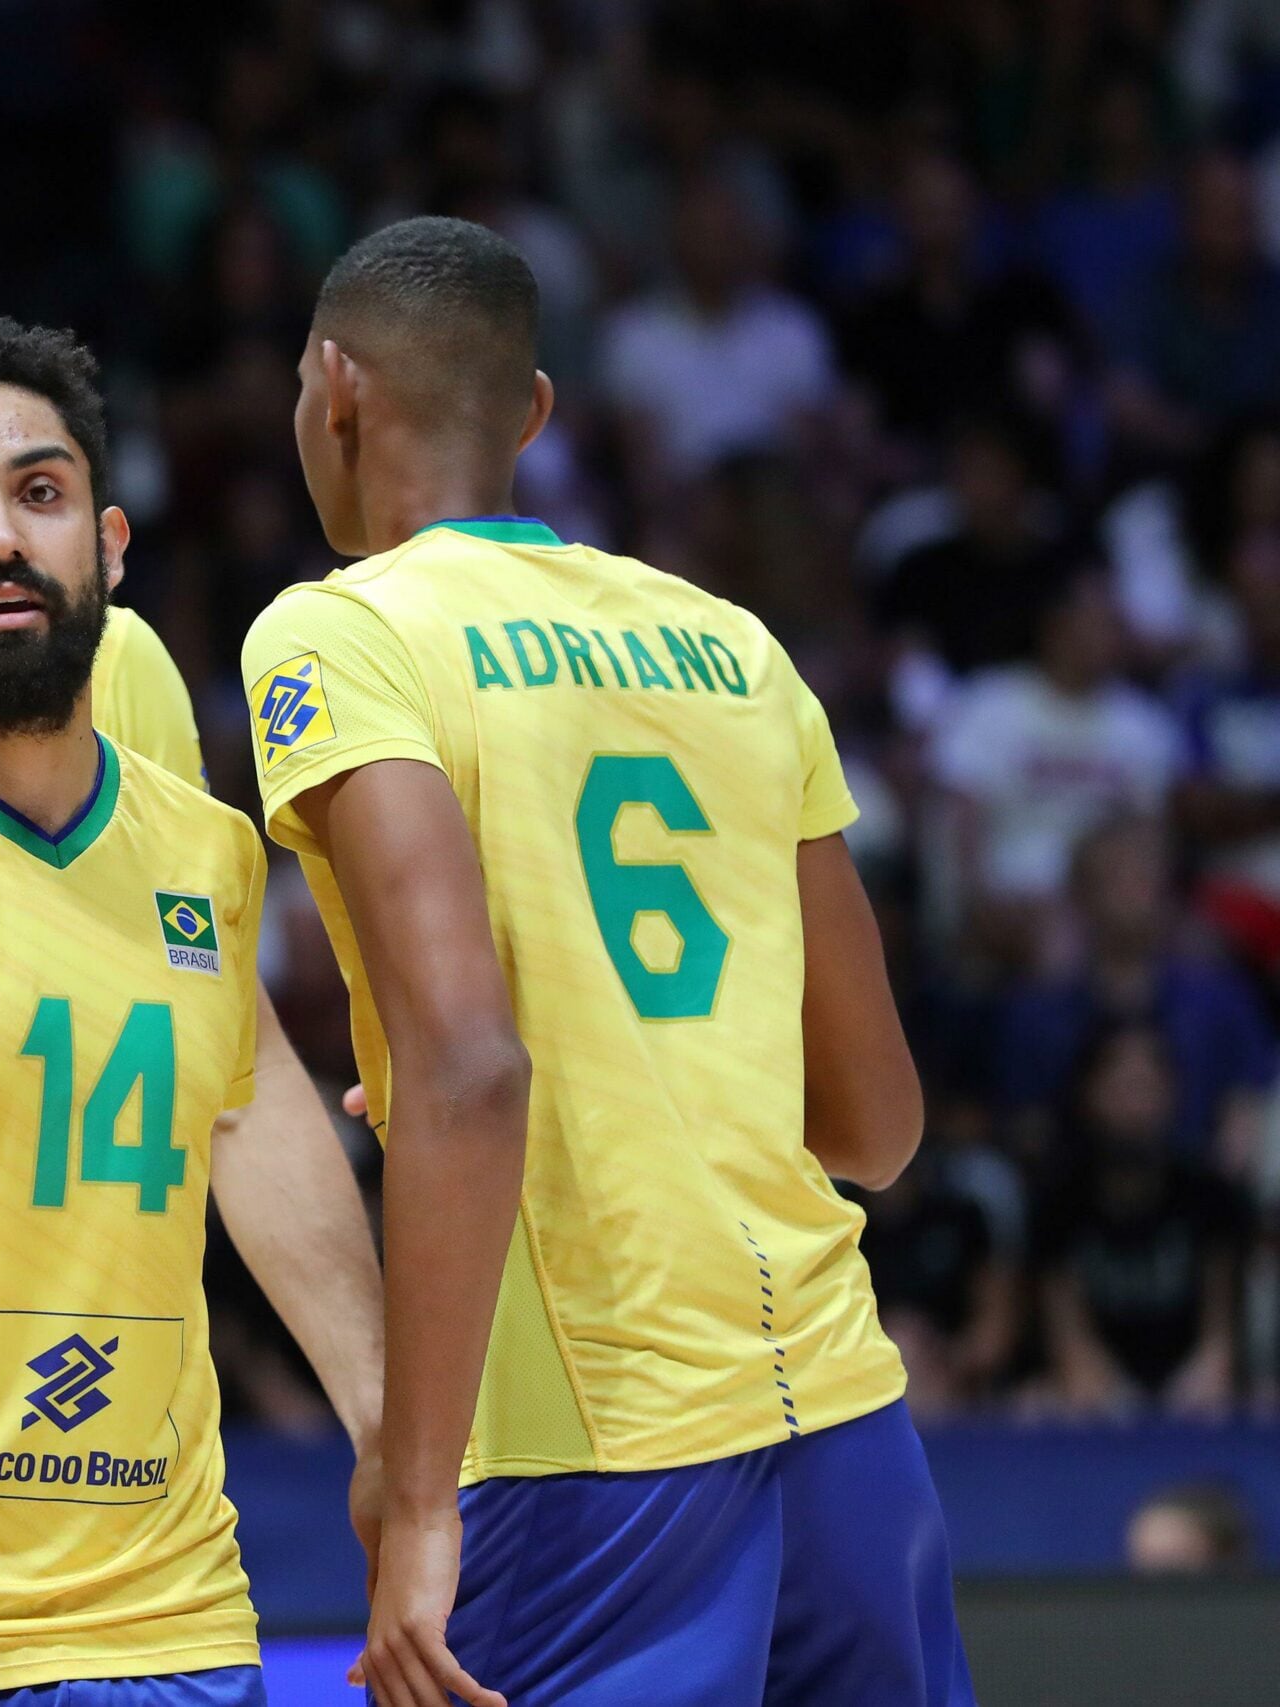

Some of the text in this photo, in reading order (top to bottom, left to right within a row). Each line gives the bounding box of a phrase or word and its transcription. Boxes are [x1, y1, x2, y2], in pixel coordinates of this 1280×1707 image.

[465, 619, 749, 697] ADRIANO
[575, 754, 731, 1020] 6
[169, 949, 218, 971] BRASIL
[20, 996, 187, 1213] 14
[40, 1454, 82, 1485] DO
[86, 1450, 168, 1488] BRASIL
